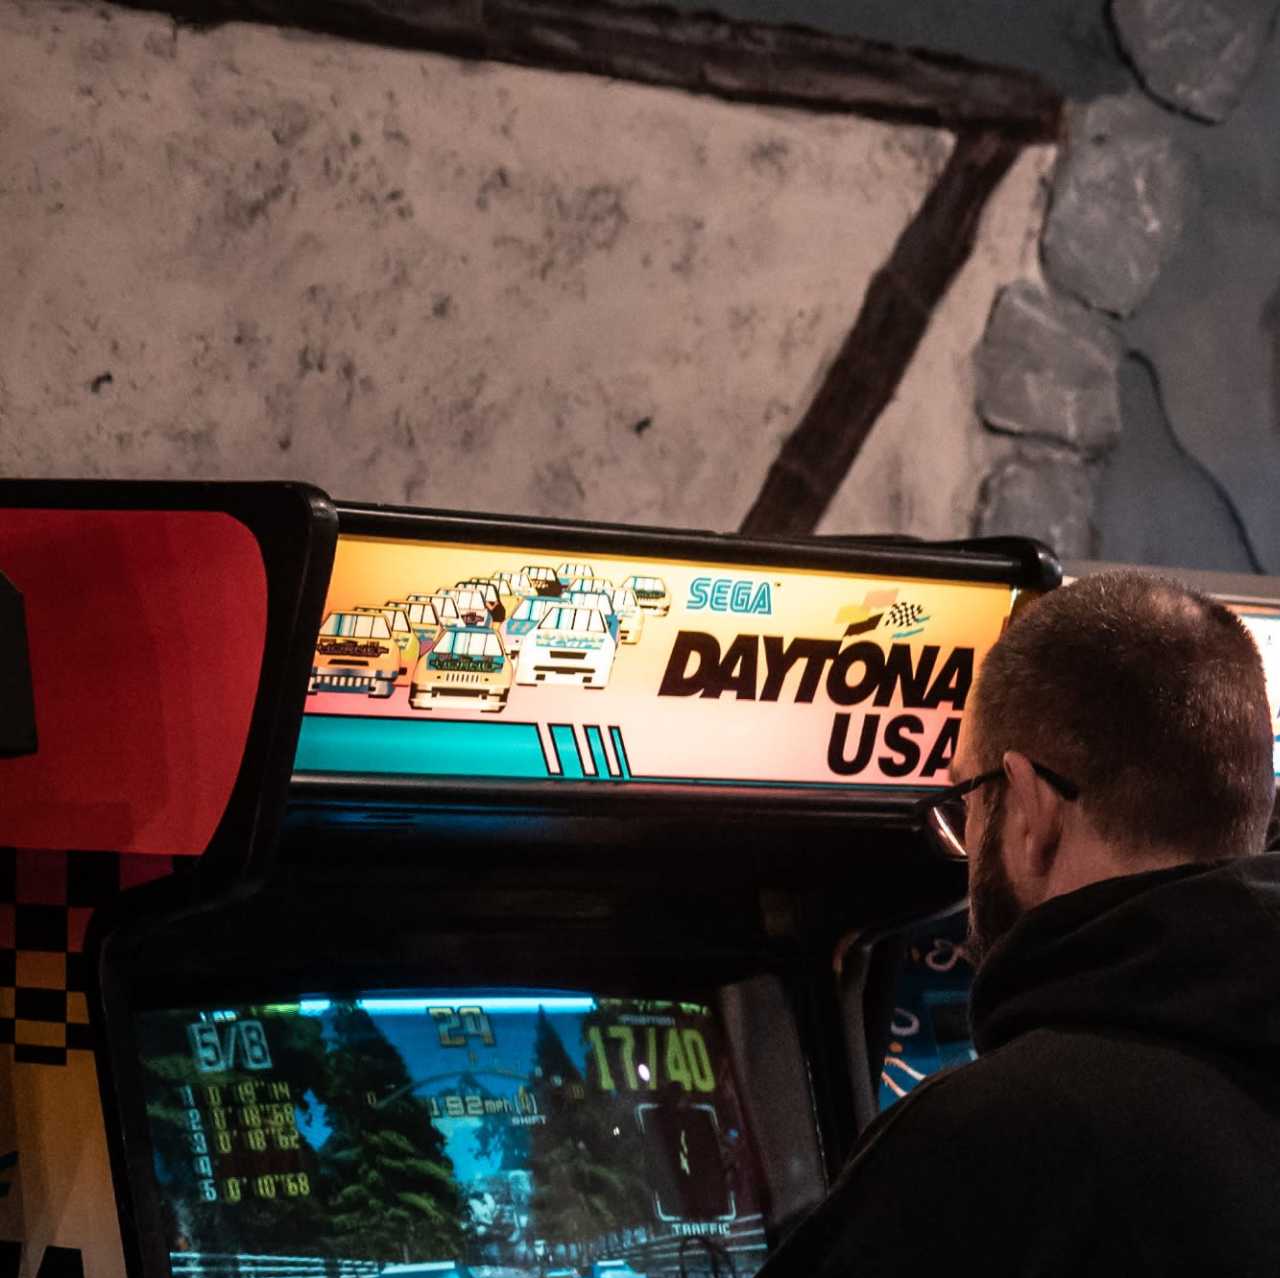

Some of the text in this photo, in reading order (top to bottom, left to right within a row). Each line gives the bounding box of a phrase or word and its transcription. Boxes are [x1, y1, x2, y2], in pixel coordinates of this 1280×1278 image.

[686, 577, 772, 616] SEGA
[657, 630, 976, 711] DAYTONA
[588, 1025, 716, 1093] 17/40
[671, 1221, 732, 1236] TRAFFIC
